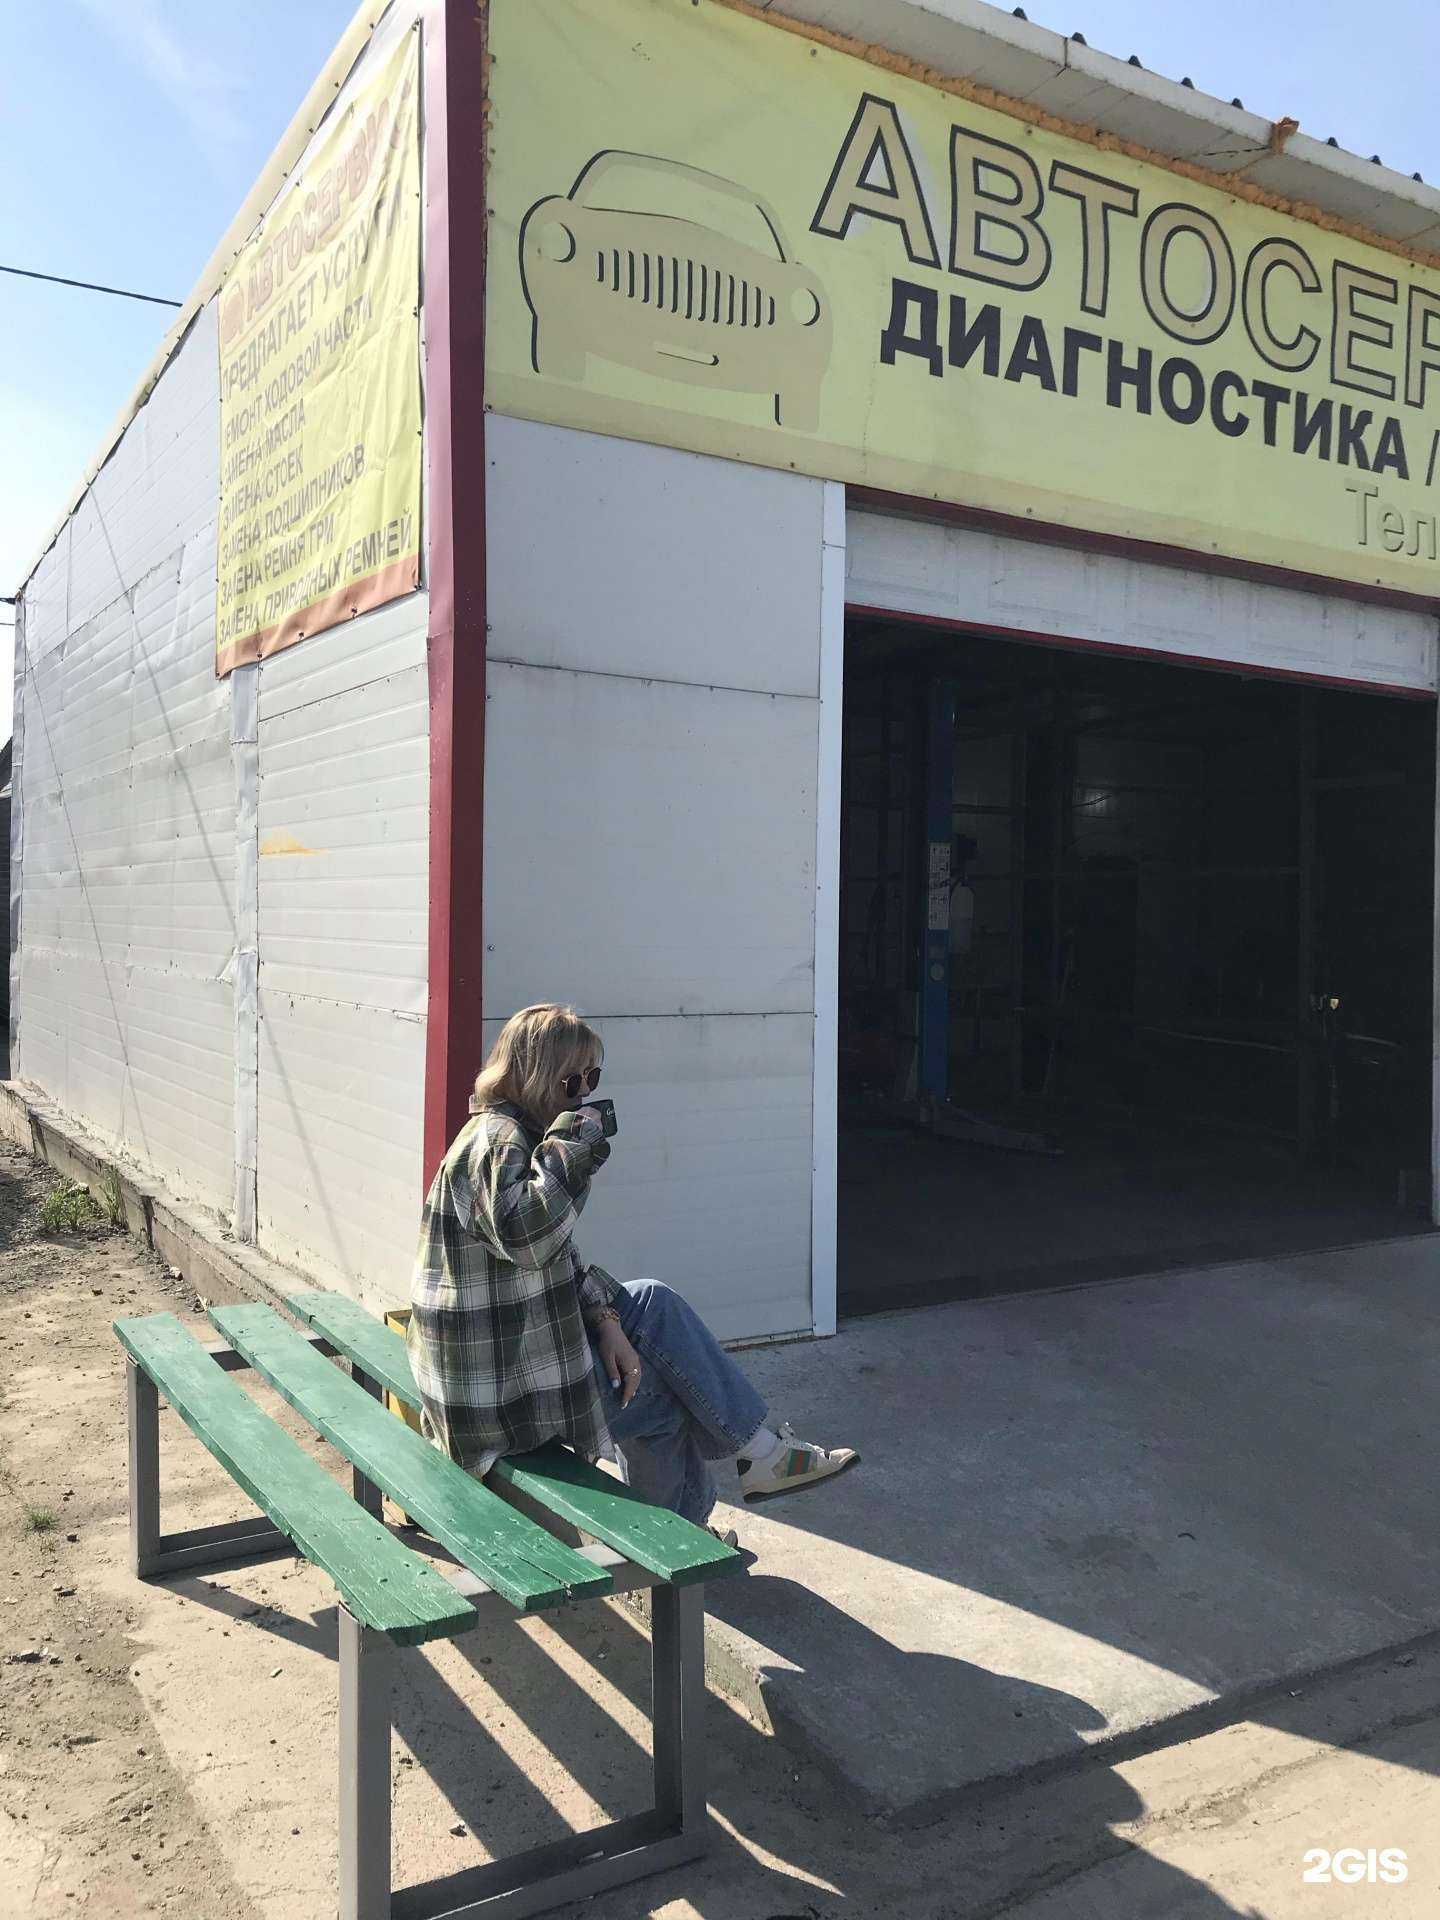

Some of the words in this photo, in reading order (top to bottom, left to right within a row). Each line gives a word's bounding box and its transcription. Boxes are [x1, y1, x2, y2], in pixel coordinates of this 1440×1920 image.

[225, 394, 263, 450] ЕМОНТ
[264, 332, 320, 412] ХОДОВОЙ
[325, 288, 372, 355] ЧАСТИ
[880, 277, 1410, 481] ДИАГНОСТИКА
[264, 397, 306, 458] МАСЛА
[223, 475, 262, 531] ЗМЕНА
[265, 443, 303, 501] СТОЕК
[265, 441, 366, 542] ПОДШИПНИКОВ
[219, 600, 260, 645] ЗАЕНА
[344, 507, 412, 576] РЕМНЕЙ
[220, 559, 263, 608] ЗАЕНА
[264, 530, 306, 582] РЕМНЯ
